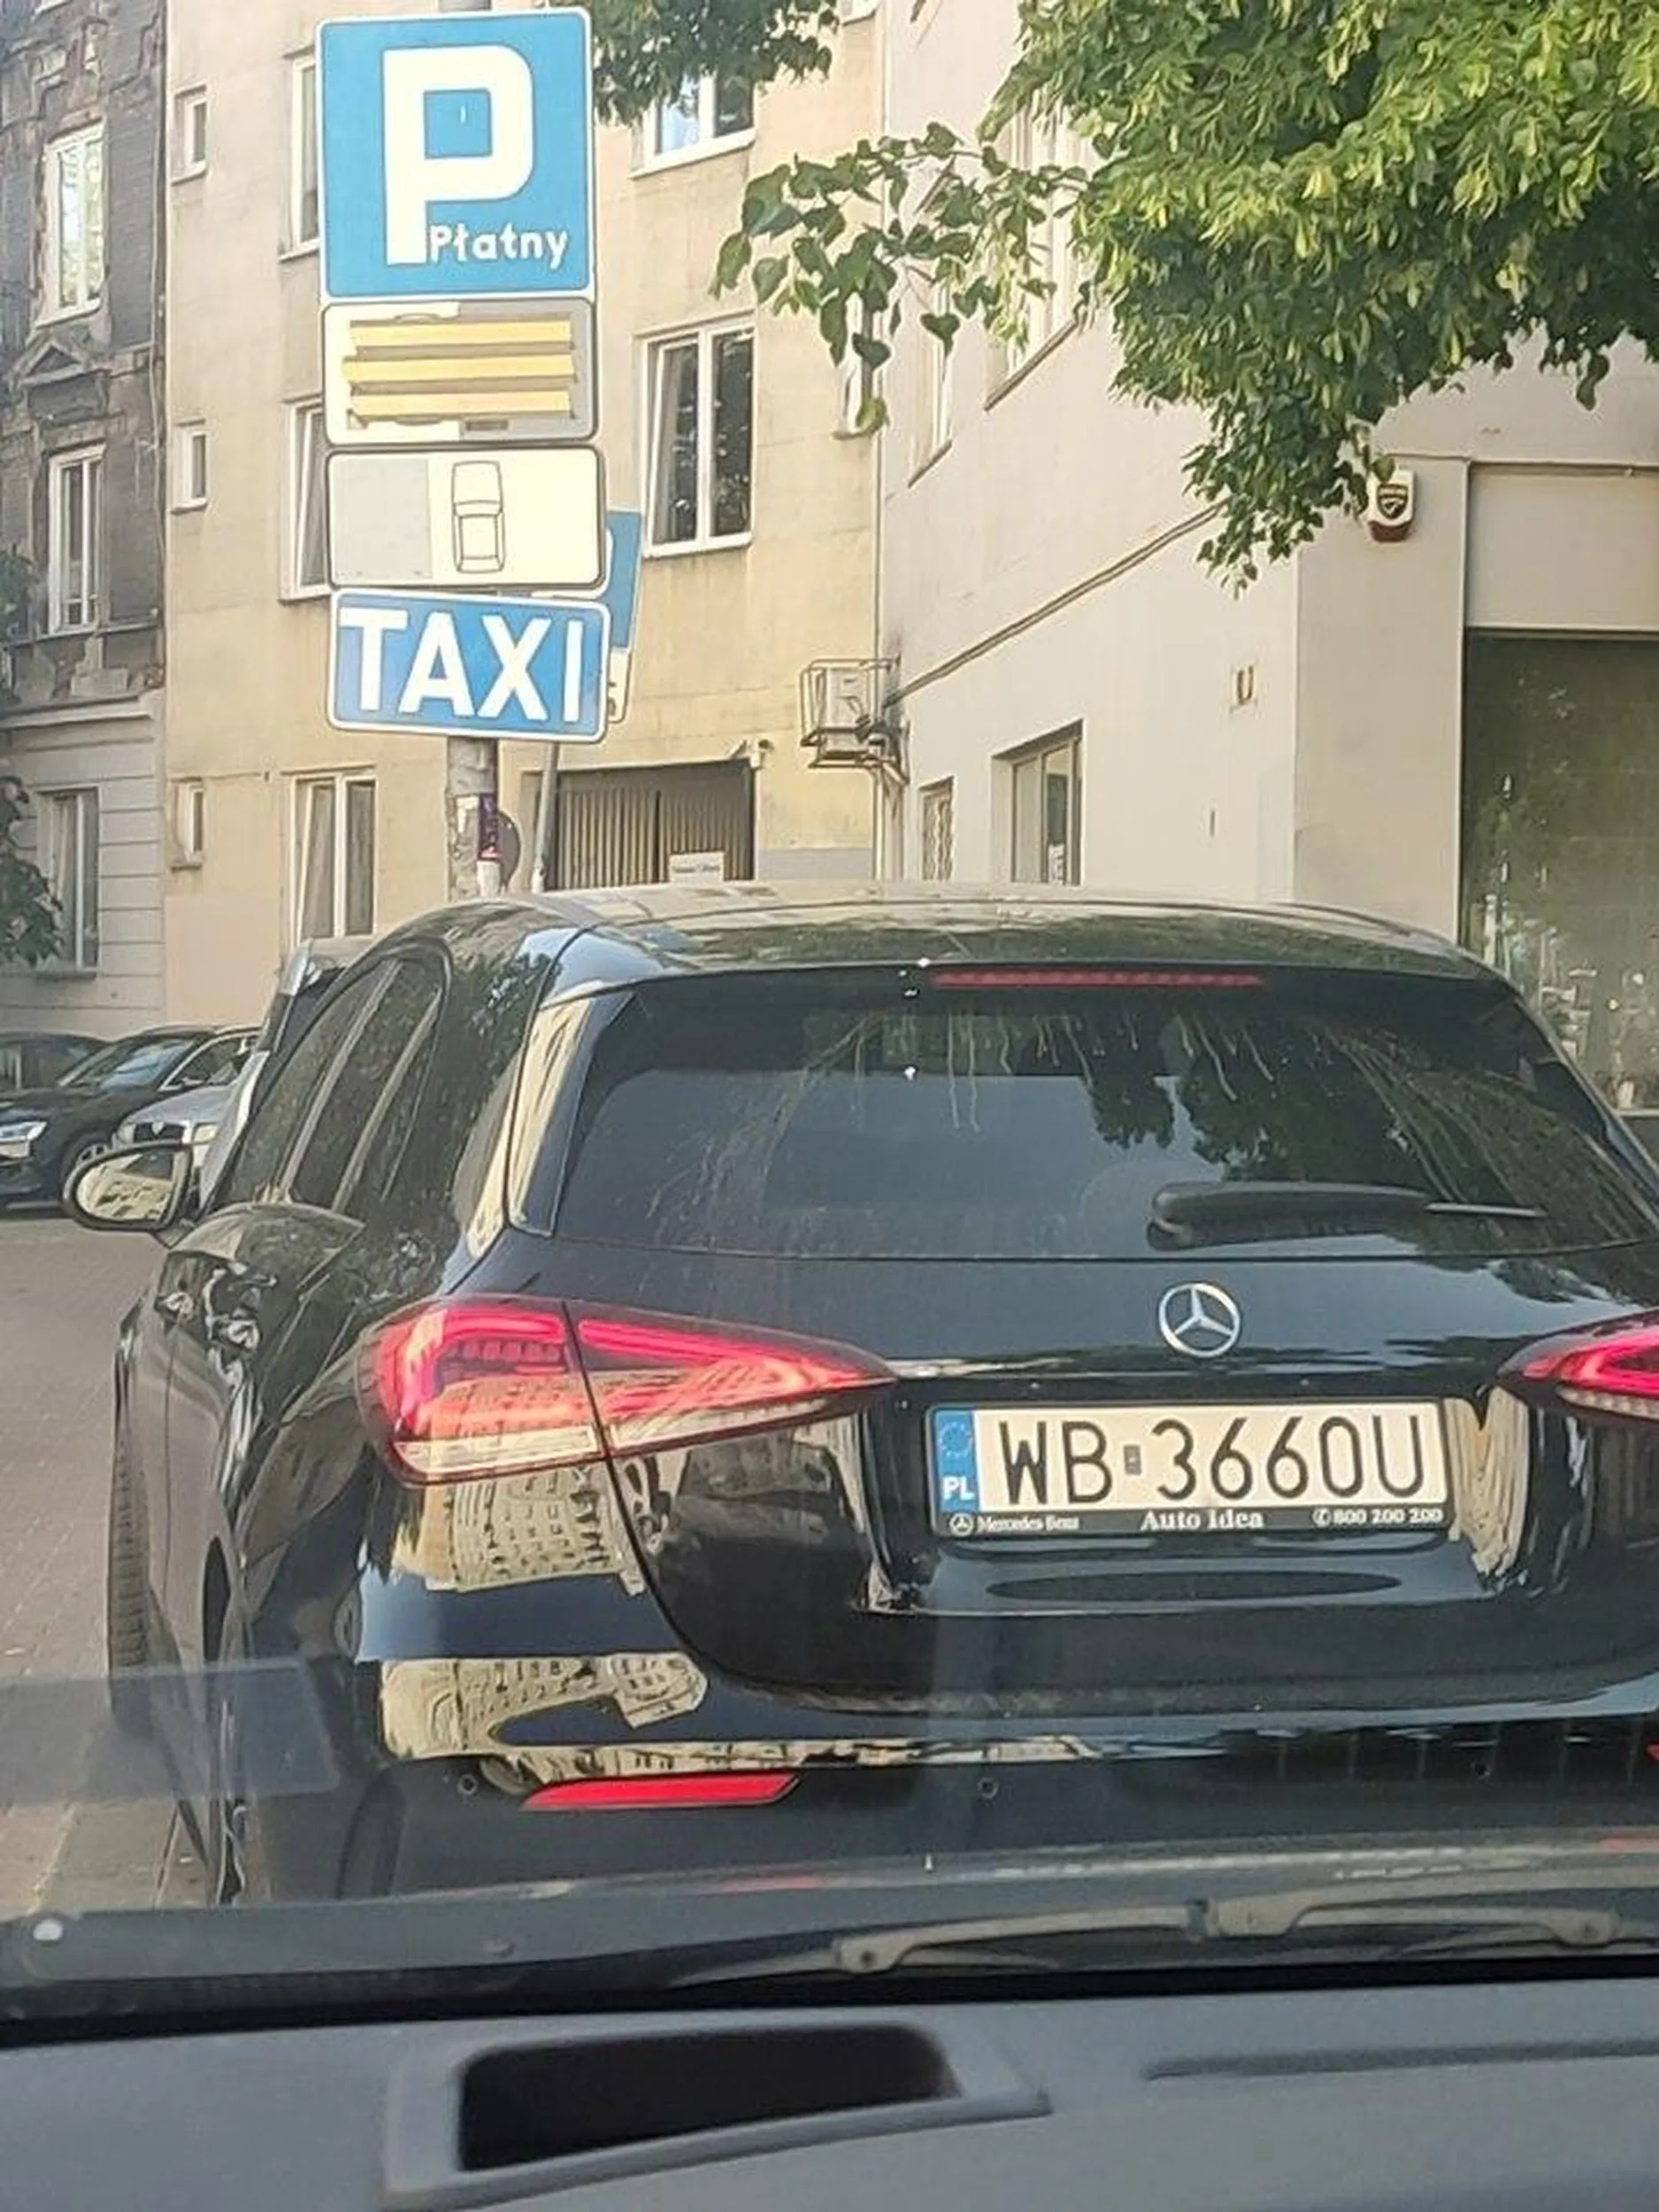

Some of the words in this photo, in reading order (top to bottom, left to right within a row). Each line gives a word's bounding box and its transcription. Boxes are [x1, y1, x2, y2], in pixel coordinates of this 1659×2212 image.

[383, 45, 533, 265] P
[431, 223, 567, 270] Płatny
[340, 608, 585, 723] TAXI
[999, 1420, 1113, 1504] WB
[1151, 1416, 1424, 1500] 3660U
[943, 1477, 975, 1501] PL
[1141, 1509, 1202, 1531] Auto
[1207, 1508, 1263, 1529] Idea
[1371, 1508, 1405, 1525] 200
[1409, 1507, 1444, 1524] 200
